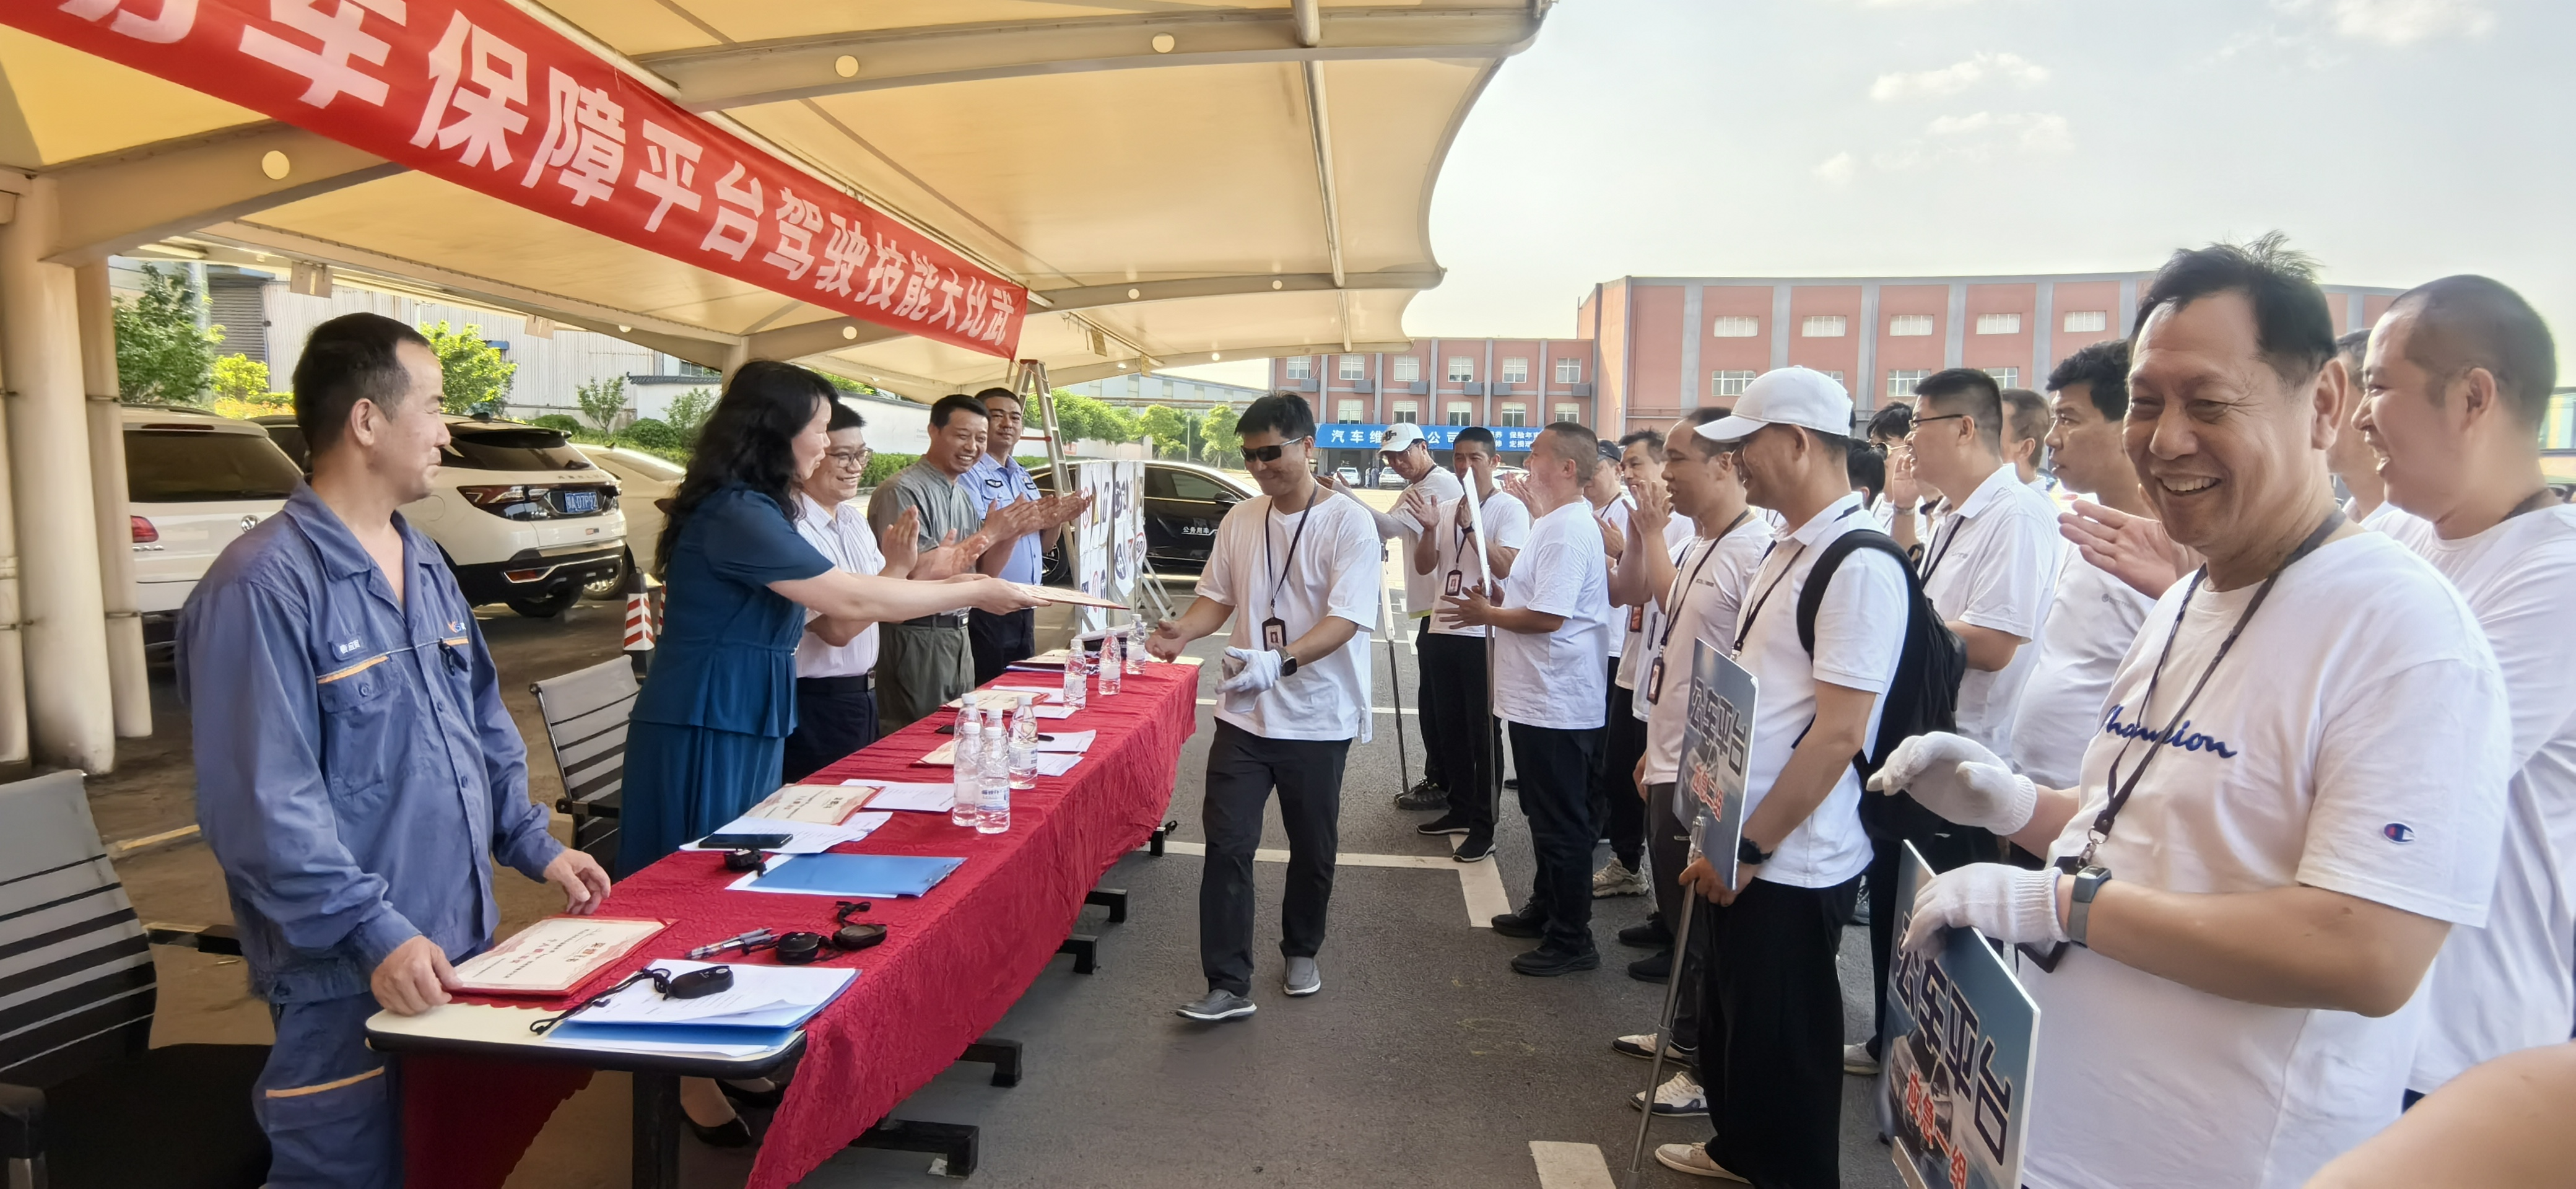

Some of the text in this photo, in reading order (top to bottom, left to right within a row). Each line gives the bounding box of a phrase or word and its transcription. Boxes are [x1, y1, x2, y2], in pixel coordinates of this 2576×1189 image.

[1690, 677, 1747, 777] 公车平台
[1907, 1064, 1967, 1189] 应急一组
